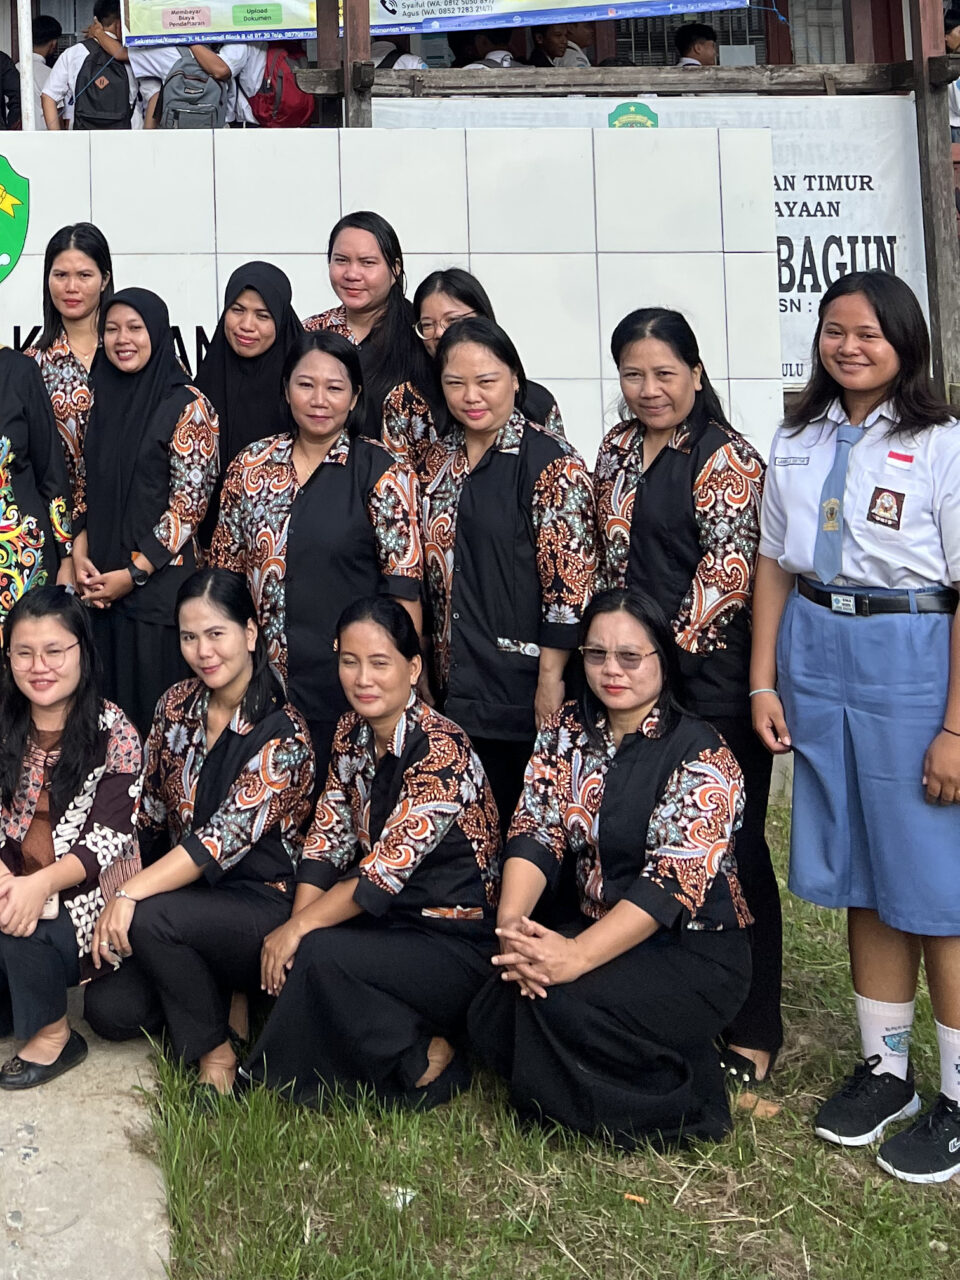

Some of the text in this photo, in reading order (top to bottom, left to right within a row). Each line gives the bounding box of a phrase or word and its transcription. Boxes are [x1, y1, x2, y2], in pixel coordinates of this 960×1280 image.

[401, 1, 425, 10] Syaiful
[402, 10, 419, 18] Agus
[438, 7, 455, 15] 0852
[774, 174, 874, 191] AN TIMUR
[774, 201, 841, 217] AYAAN
[777, 234, 896, 293] BAGUN
[779, 299, 801, 312] SN
[782, 363, 803, 377] ULU
